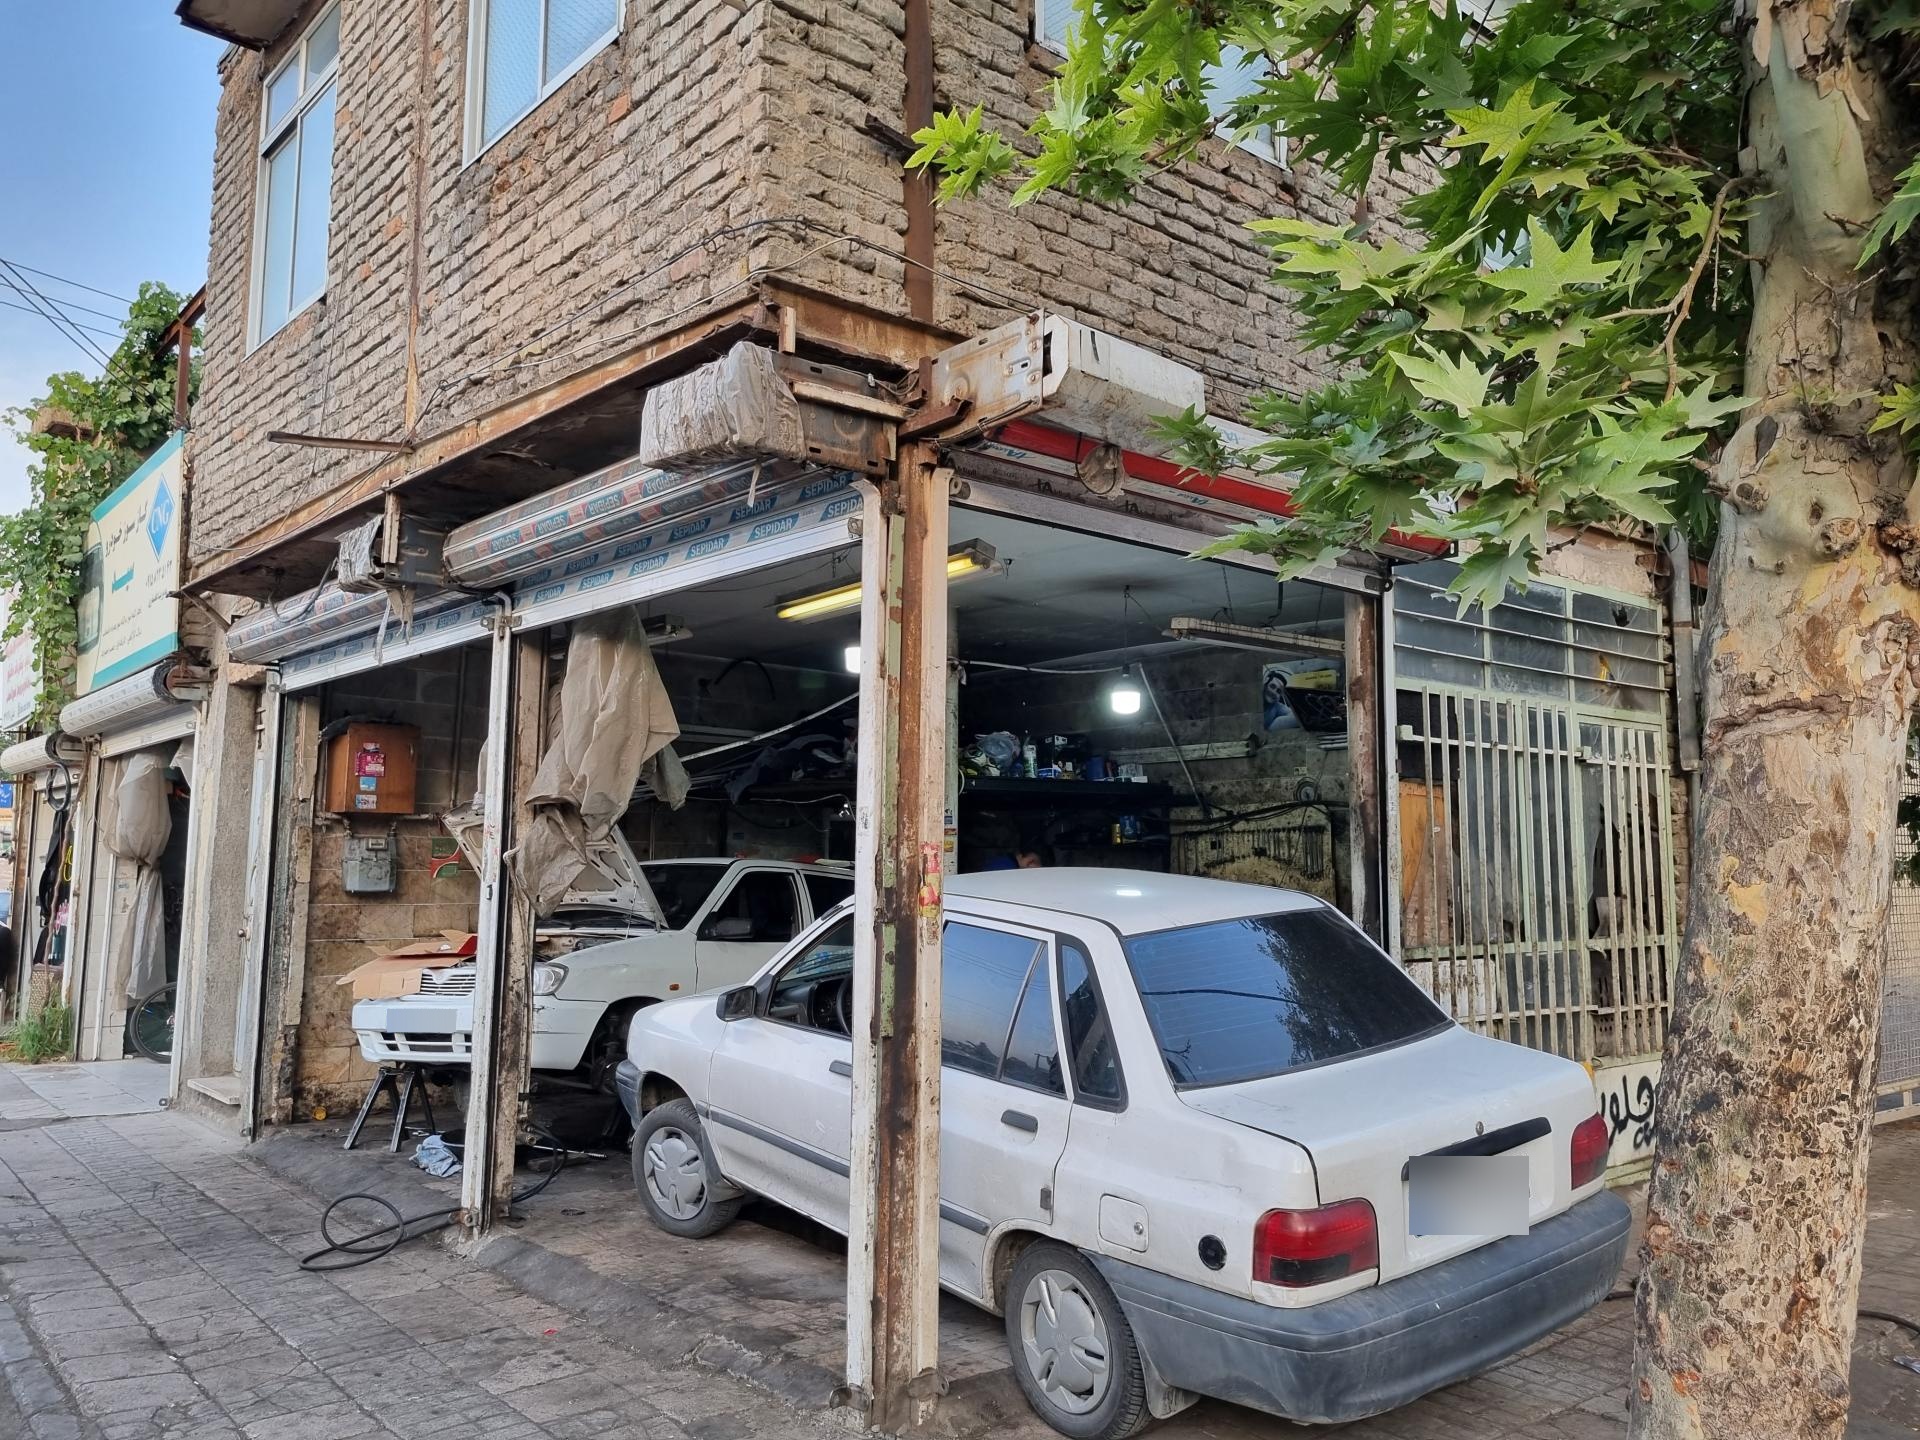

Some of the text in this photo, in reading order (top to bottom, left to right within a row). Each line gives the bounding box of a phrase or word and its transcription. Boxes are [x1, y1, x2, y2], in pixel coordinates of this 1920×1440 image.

[152, 499, 170, 533] CNG
[735, 500, 772, 519] SEPIDAR
[828, 498, 863, 516] SEPIDA
[673, 520, 706, 538] SEPIDAR
[754, 517, 794, 537] SEPIDAR
[617, 538, 649, 557] SEPIDAR
[690, 536, 725, 557] SEPIDAR
[568, 556, 596, 571] SEPIDAR
[633, 556, 666, 574] SEPIDAR
[582, 572, 611, 589] SEPIDAR
[535, 586, 563, 600] SEPIDAR
